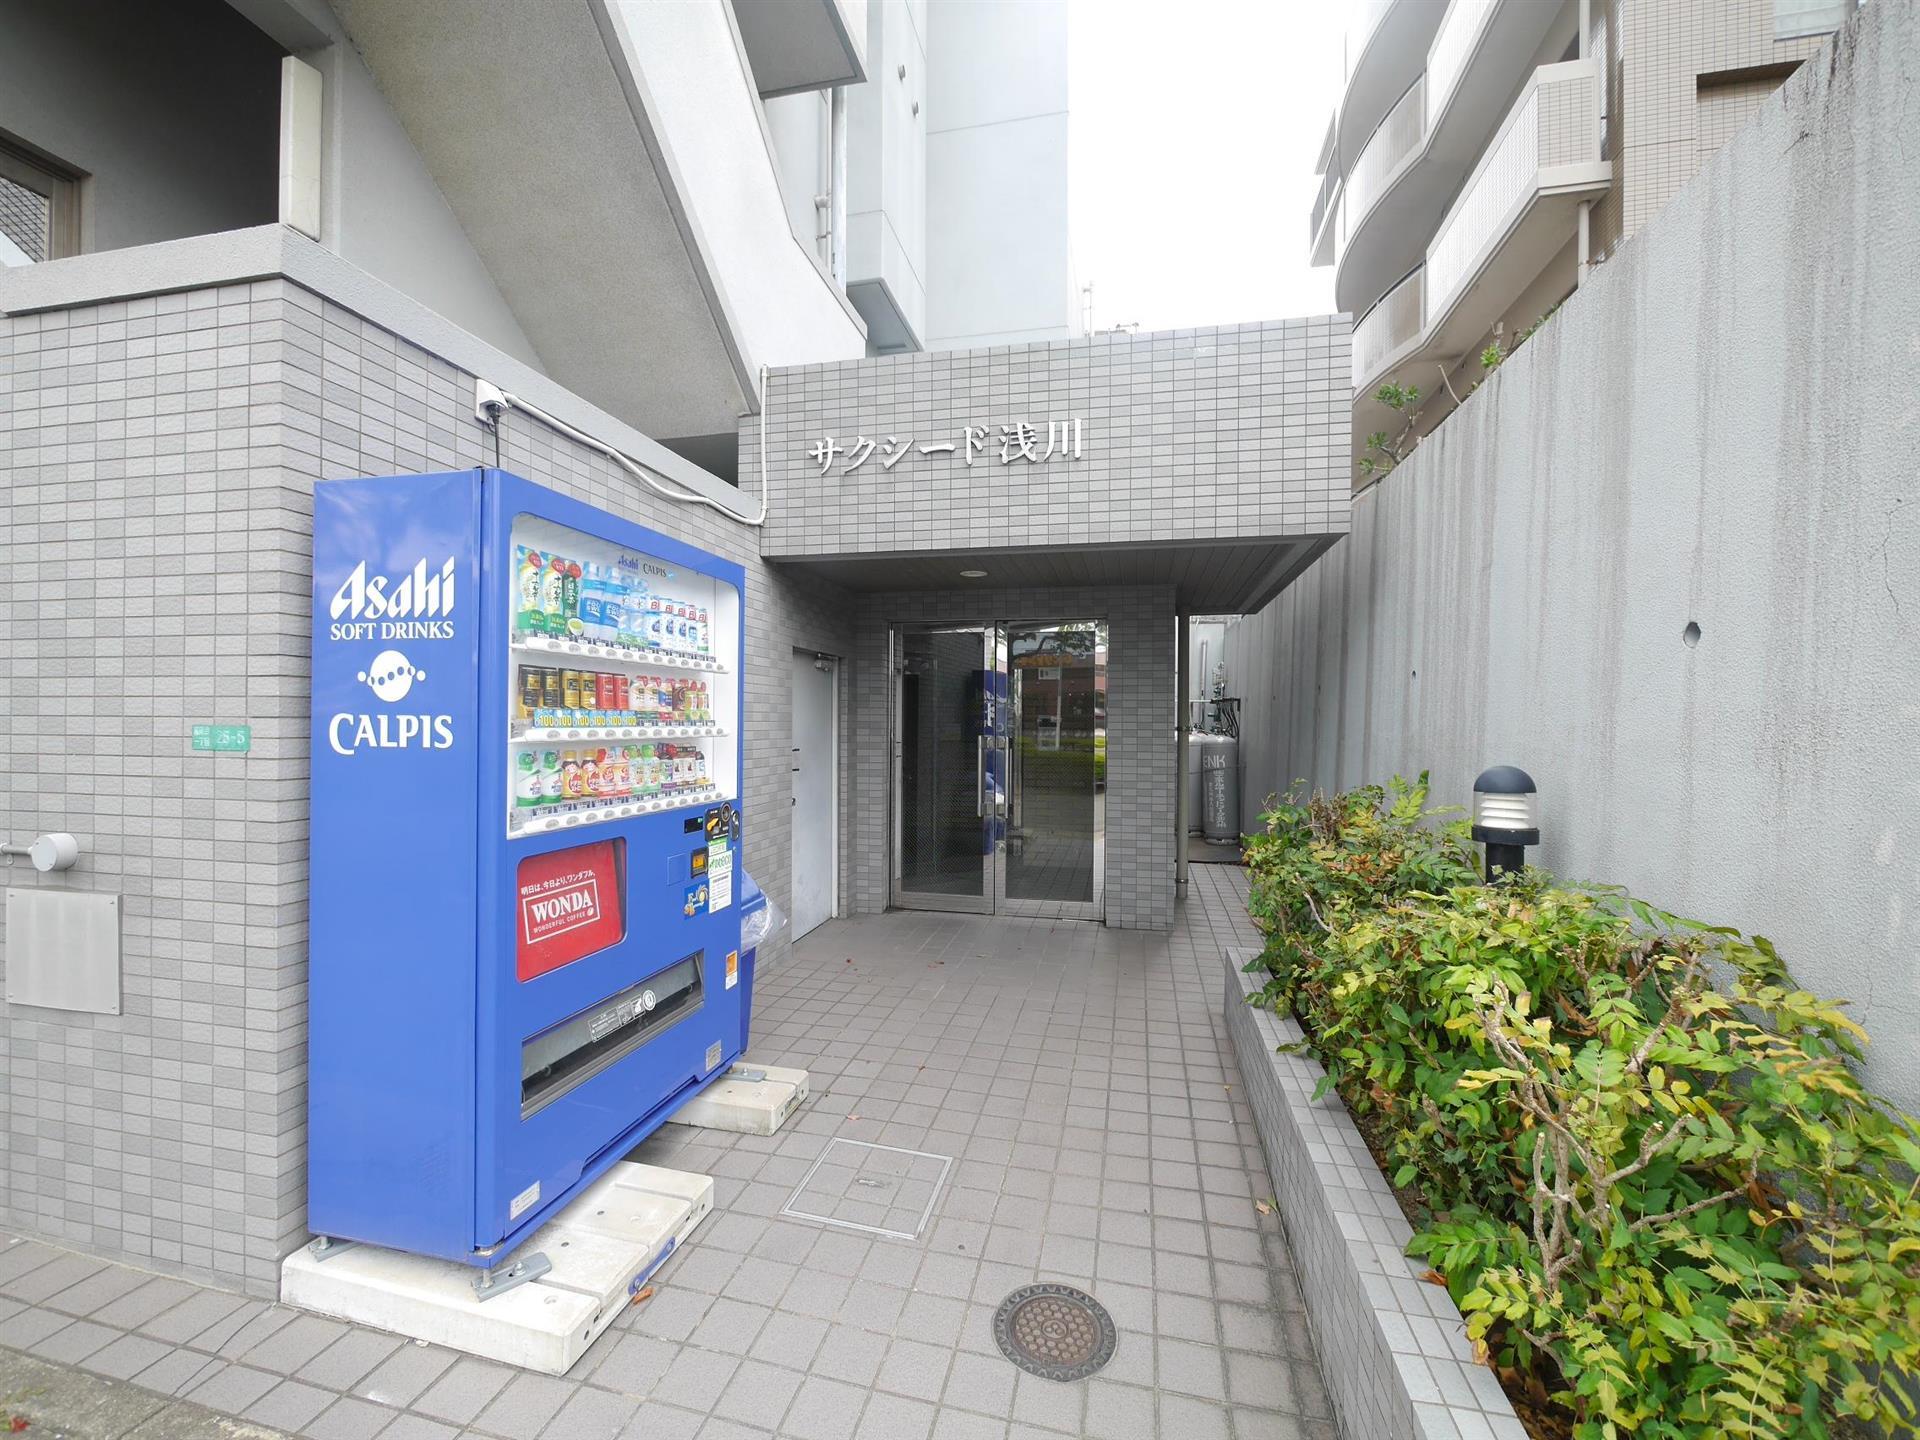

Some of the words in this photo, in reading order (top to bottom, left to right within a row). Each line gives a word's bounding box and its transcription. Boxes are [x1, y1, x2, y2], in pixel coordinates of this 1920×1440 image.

[808, 417, 1083, 476] サクシード浅川
[618, 554, 639, 570] Asahi
[642, 563, 667, 578] CALPIS
[330, 556, 455, 620] Asahi
[330, 622, 377, 641] SOFT
[381, 620, 455, 640] DRINKS
[216, 730, 246, 744] 25-5
[329, 712, 454, 756] CALPIS
[531, 889, 593, 924] WONDA
[533, 917, 566, 934] WONDERFUL
[566, 911, 586, 922] COFFEE
